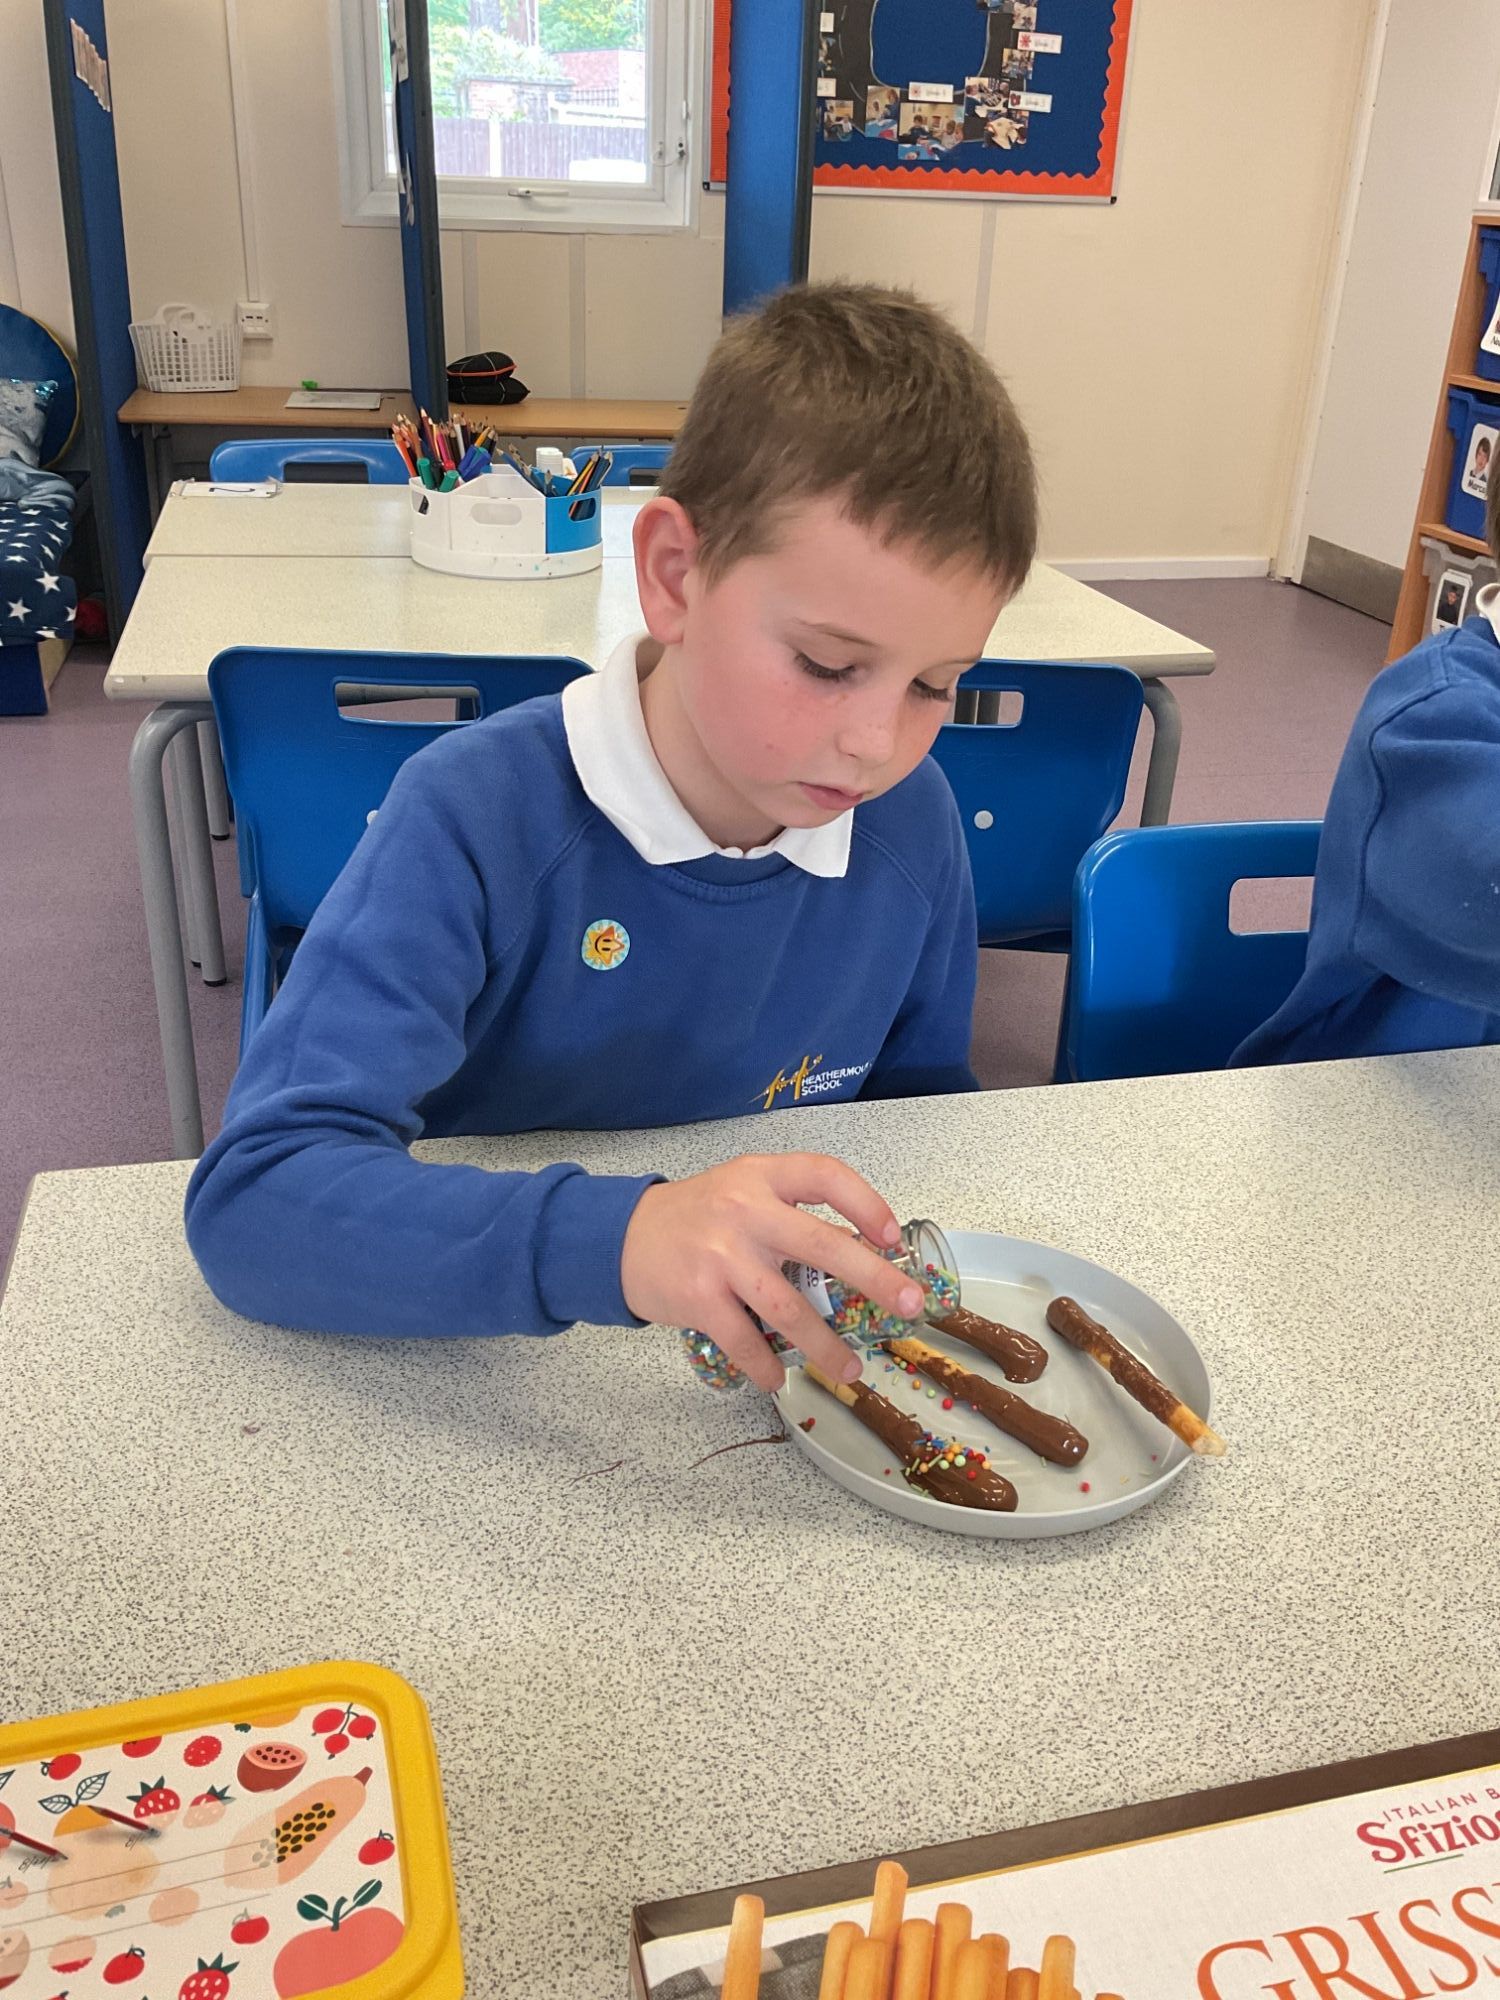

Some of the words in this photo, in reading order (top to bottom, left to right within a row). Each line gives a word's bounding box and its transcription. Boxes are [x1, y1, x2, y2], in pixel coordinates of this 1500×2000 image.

[801, 1078, 843, 1096] SCHOOL
[1382, 1792, 1478, 1822] ITALIAN
[1356, 1810, 1500, 1863] Sfizio
[1197, 1882, 1500, 2000] GRISS
